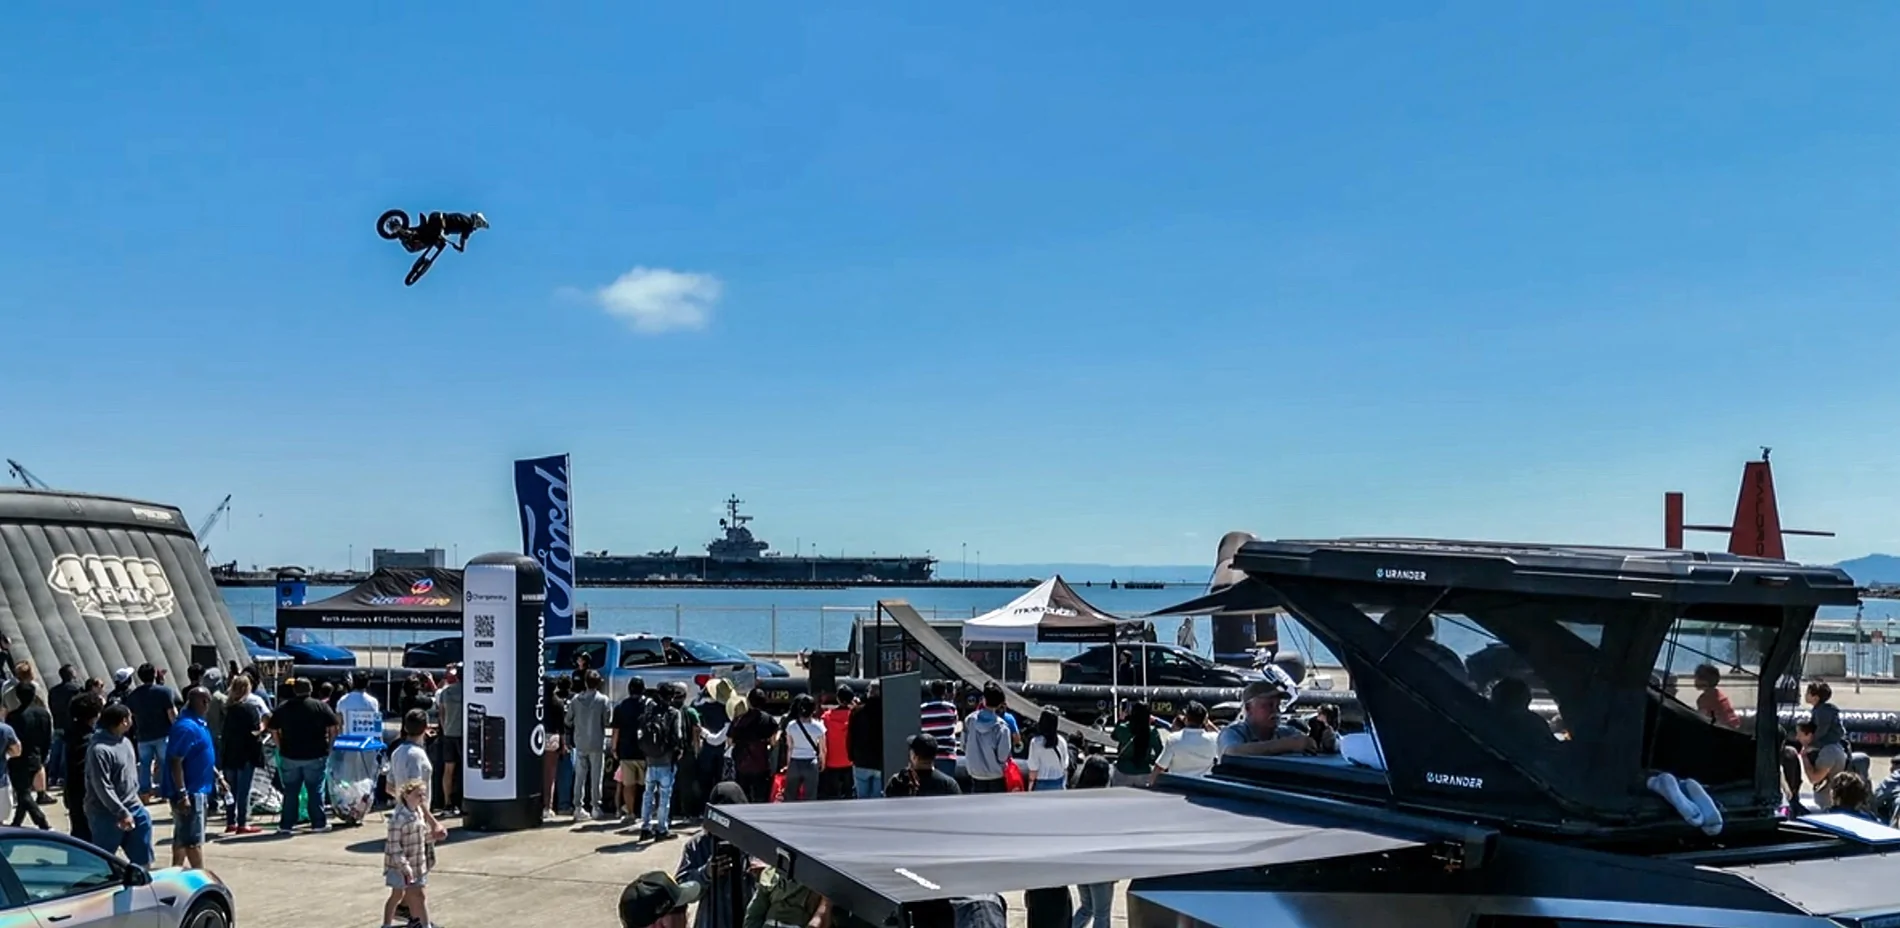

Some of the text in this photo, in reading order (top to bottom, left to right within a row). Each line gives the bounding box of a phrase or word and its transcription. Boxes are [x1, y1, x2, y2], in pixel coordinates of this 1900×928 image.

[1756, 470, 1765, 557] SAILDRO
[525, 465, 573, 618] Ford
[1385, 569, 1427, 581] URANDER
[383, 616, 408, 624] Electric
[435, 617, 461, 625] Festival
[1435, 773, 1483, 789] URANDER
